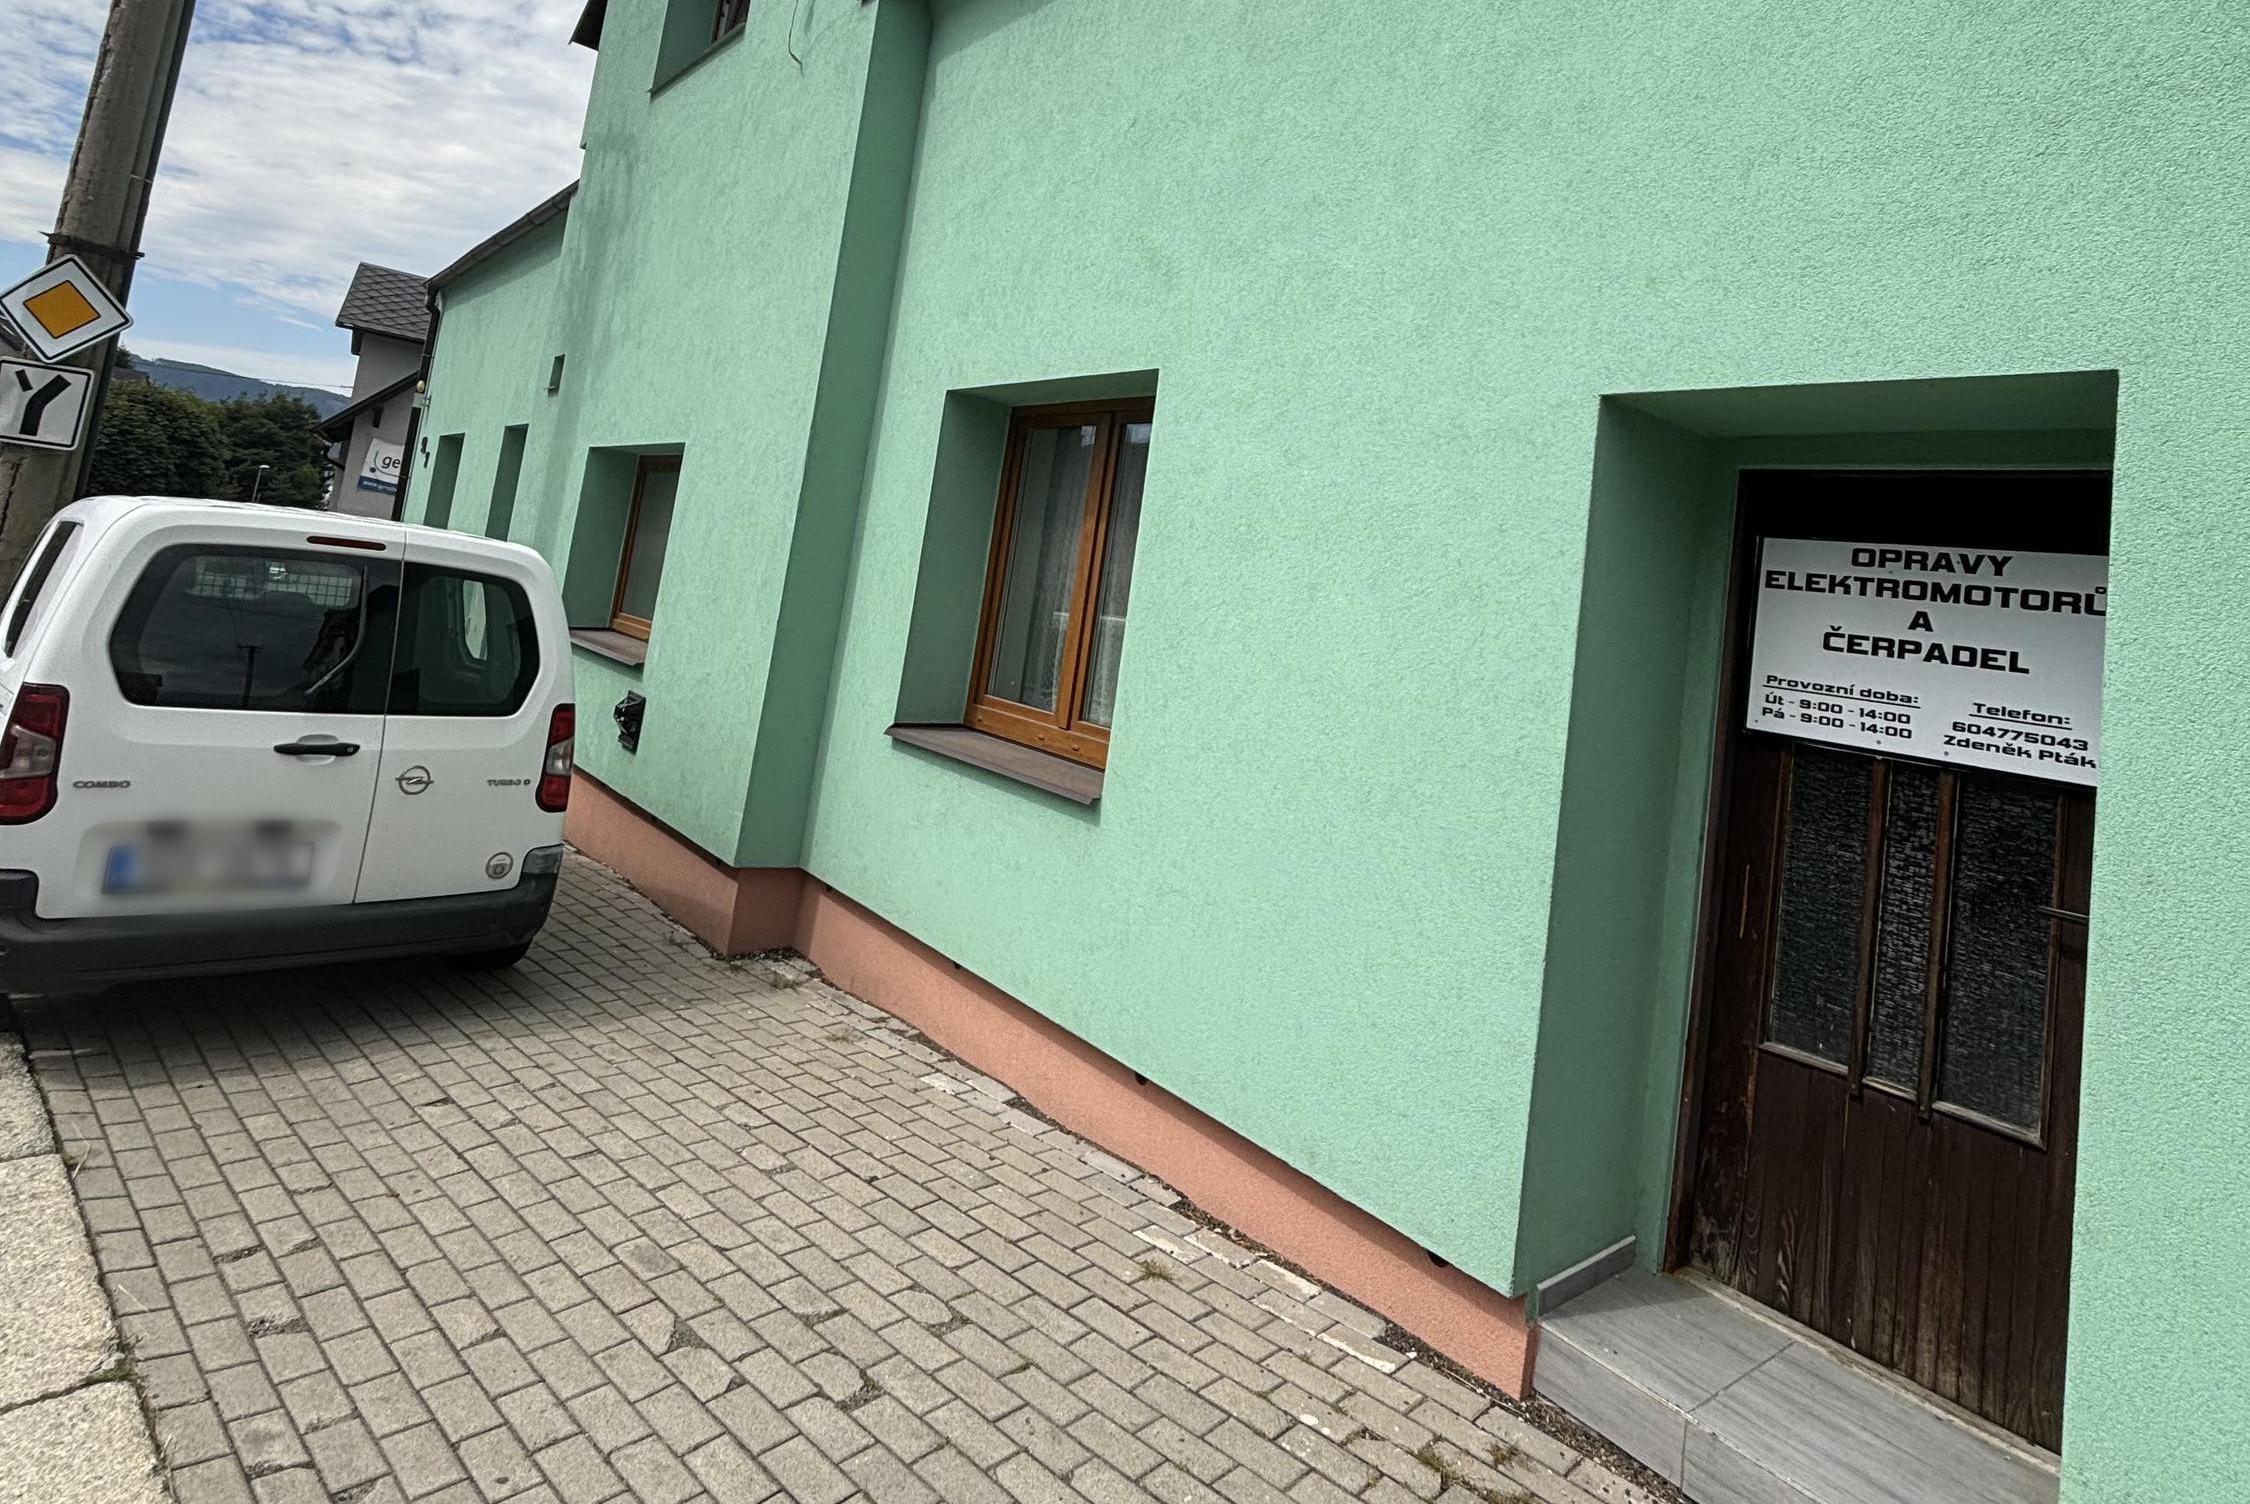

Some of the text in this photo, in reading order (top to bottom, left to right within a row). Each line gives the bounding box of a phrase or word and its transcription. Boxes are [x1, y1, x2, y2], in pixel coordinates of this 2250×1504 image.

[1851, 548, 2013, 577] OPRAVY
[1765, 570, 2107, 616] ELEKTROMOTORŮ
[1907, 610, 1934, 632] A
[1823, 625, 2030, 674] ČERPADEL
[1766, 674, 1919, 704] Provozní doba:
[1762, 707, 1785, 719] Pá
[1800, 713, 1844, 728] 9:00
[1860, 722, 1912, 739] 14:00
[1765, 692, 1784, 705] Út
[1799, 699, 1843, 714] 9:00
[1859, 707, 1911, 724] 14:00
[1973, 702, 2071, 725] Telefon:
[1952, 721, 2088, 751] 604775043
[1943, 735, 2096, 769] Zdeněk Pták
[73, 780, 131, 789] COMBO
